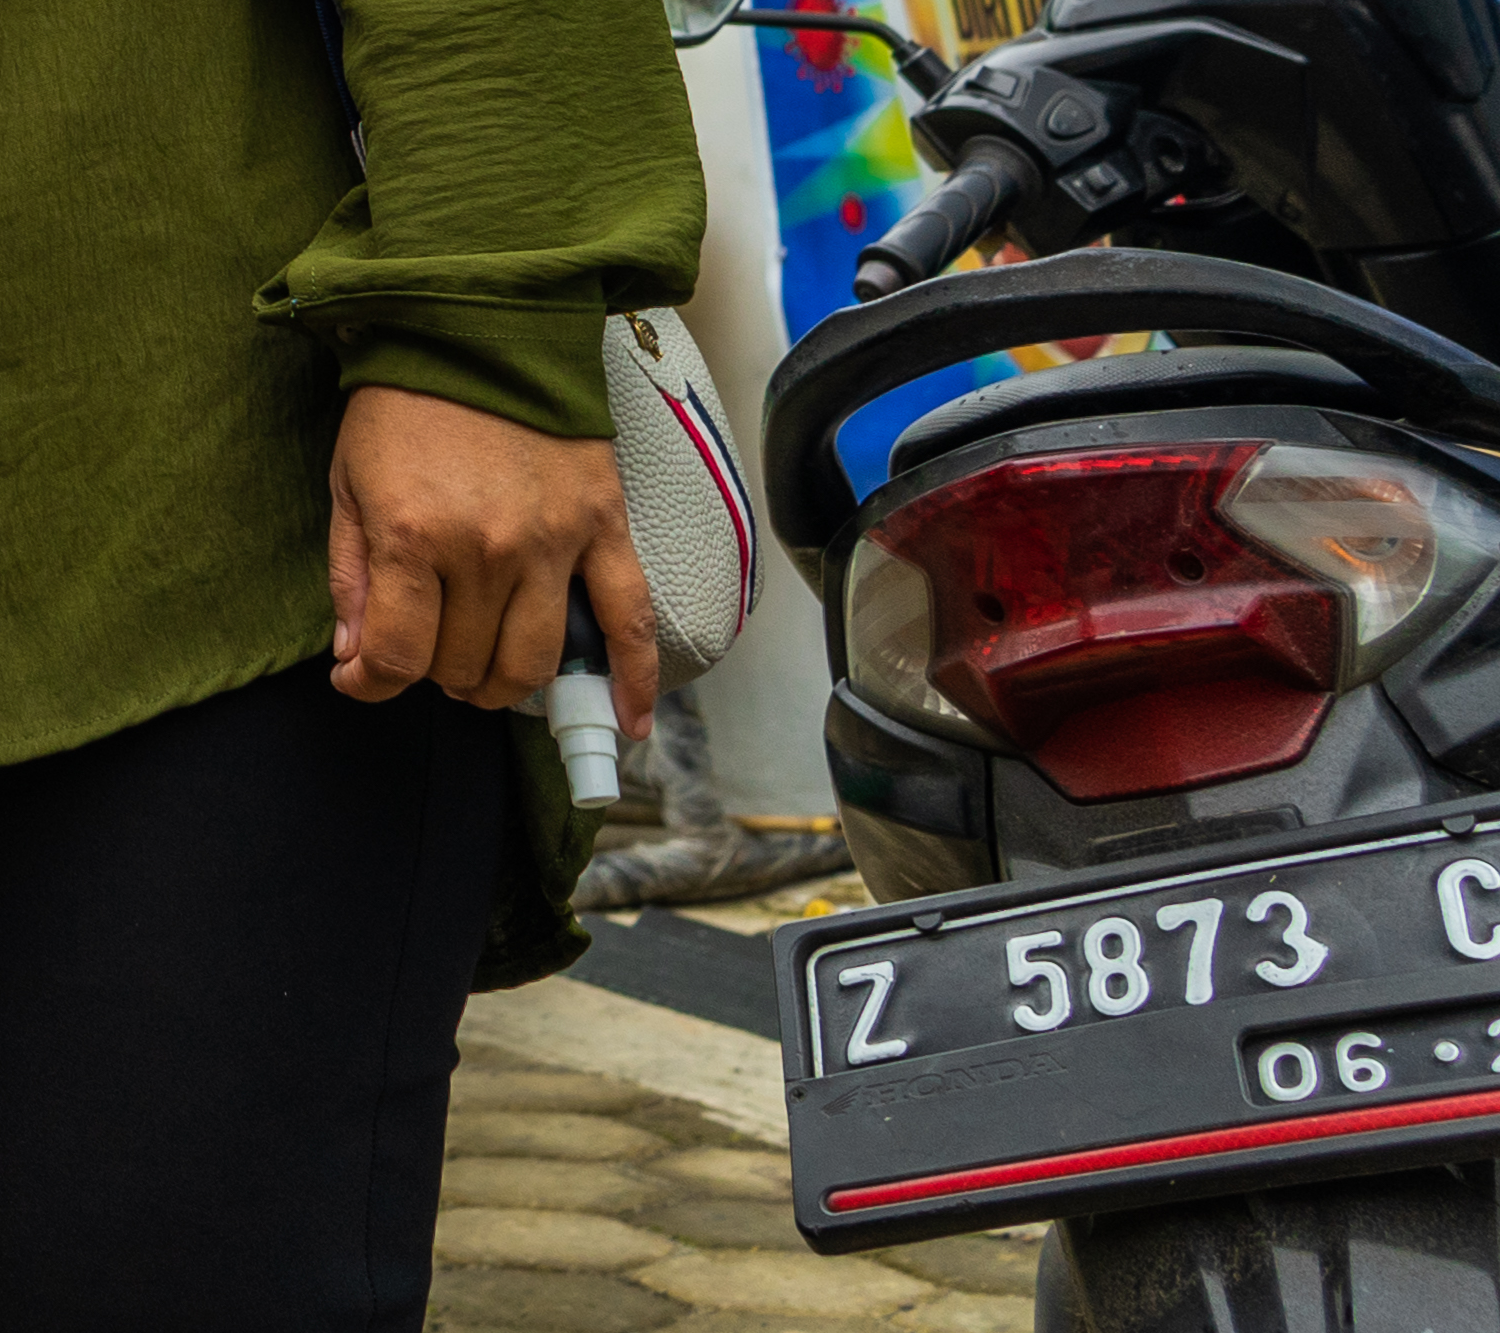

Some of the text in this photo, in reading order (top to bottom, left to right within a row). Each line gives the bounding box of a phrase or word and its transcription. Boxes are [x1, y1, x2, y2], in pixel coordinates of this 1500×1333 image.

[838, 960, 908, 1065] Z
[1006, 890, 1330, 1032] 5873
[862, 1050, 1069, 1110] HONDA
